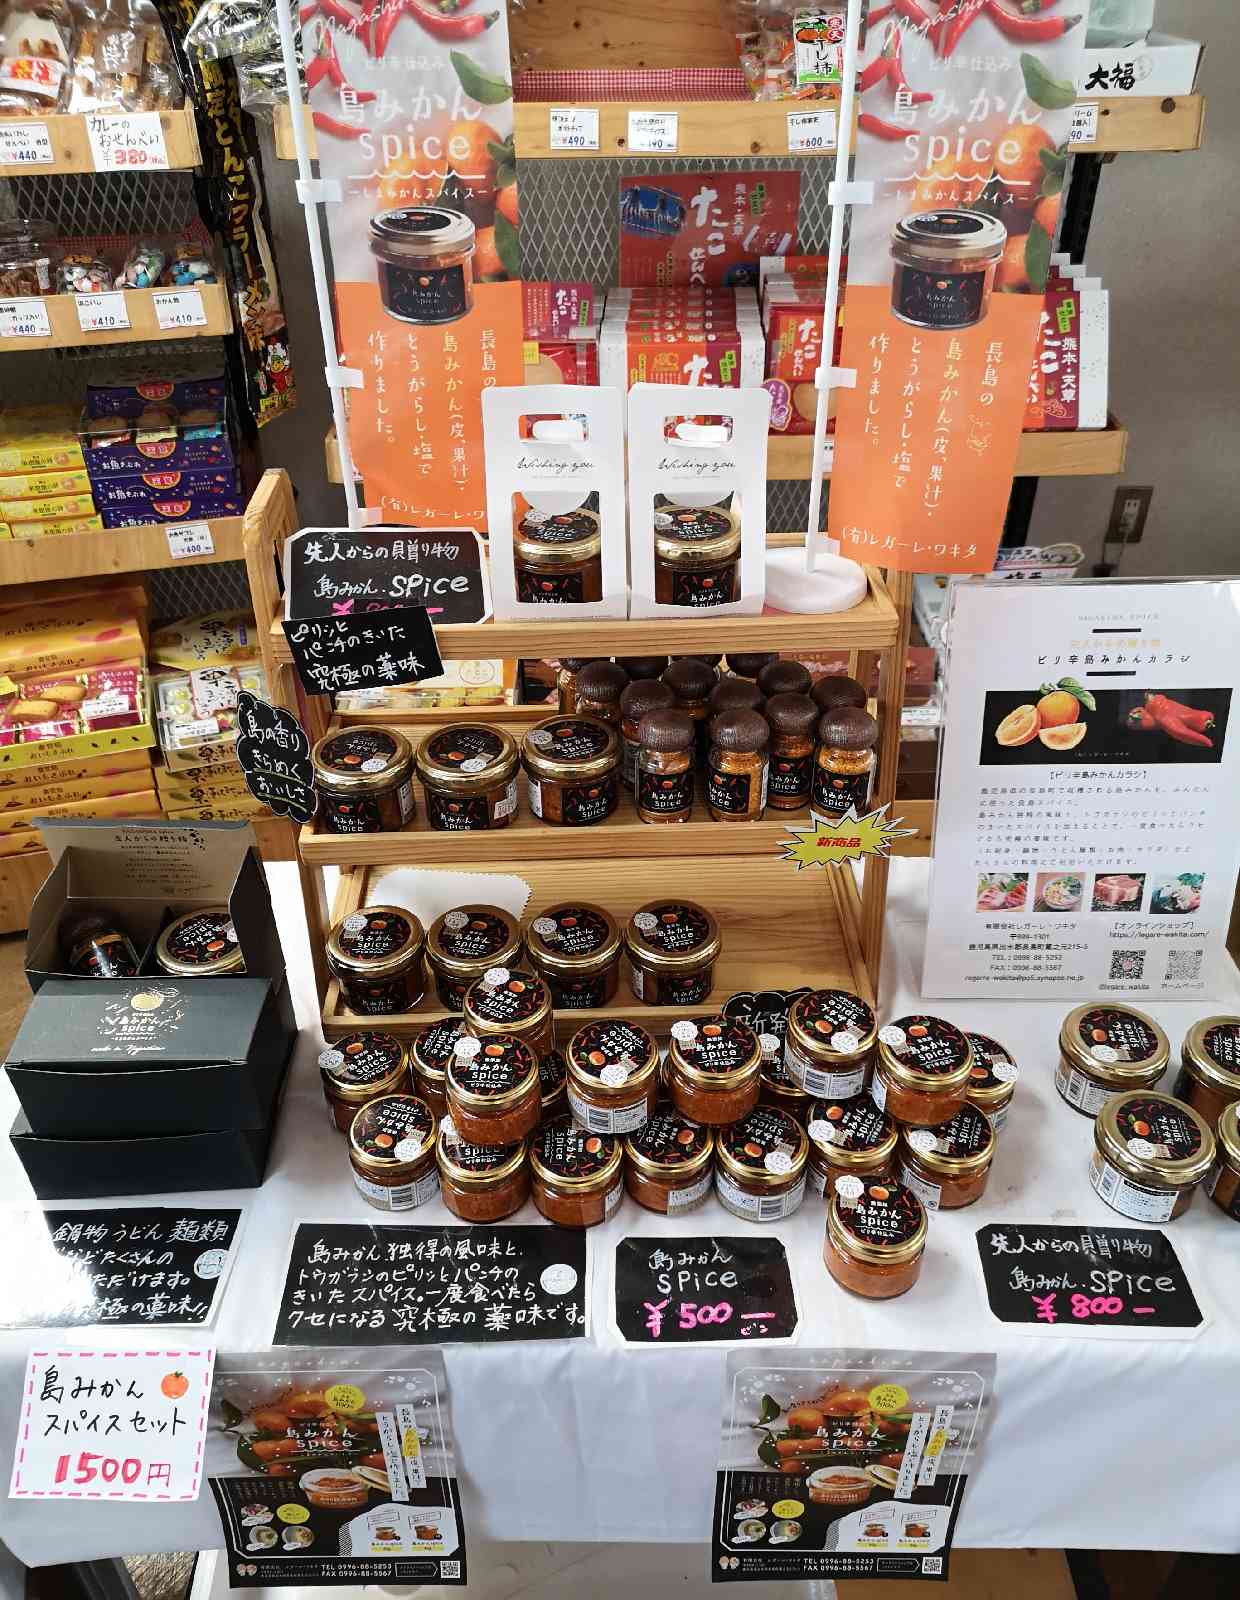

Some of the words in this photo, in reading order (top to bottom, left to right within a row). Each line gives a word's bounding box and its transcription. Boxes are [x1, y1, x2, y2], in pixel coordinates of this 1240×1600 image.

[1084, 62, 1136, 91] 大福
[340, 83, 482, 126] 島みかん
[894, 86, 1042, 126] 島みかん
[90, 116, 130, 133] カレーの
[99, 131, 160, 147] おせんべい
[359, 124, 472, 167] spice
[903, 126, 1023, 173] spice
[690, 186, 730, 256] たこ
[479, 329, 497, 387] 長島の
[1060, 337, 1079, 404] 熊本・天草
[368, 331, 395, 443] 作りました。
[980, 341, 1003, 406] 長島の
[864, 334, 890, 448] 作りました。
[516, 456, 568, 475] Wishing
[657, 457, 708, 475] Wishing
[303, 539, 460, 564] 先人からの贈り物
[842, 526, 977, 559] (有)レガーレ・ワキタ
[303, 625, 406, 660] パンチのきいた
[307, 651, 425, 692] 究極の薬味
[246, 710, 300, 752] 島の香り
[251, 749, 301, 780] きらめく
[256, 775, 306, 803] おいしさ
[816, 836, 862, 848] 新商品
[120, 1024, 156, 1033] spice
[469, 1062, 513, 1073] 島みかん
[701, 1049, 737, 1060] spice
[919, 1048, 952, 1061] spice
[471, 1071, 509, 1080] spice
[855, 1203, 902, 1220] 島みかん
[860, 1215, 899, 1229] spice
[52, 1222, 108, 1244] 鍋物
[113, 1223, 164, 1243] うどん
[166, 1218, 229, 1243] 麺類
[989, 1233, 1153, 1258] 先人からの贈り物
[649, 1249, 733, 1271] 島みかん
[40, 1364, 144, 1404] 島みかん
[44, 1406, 187, 1437] スパイスセット
[286, 1426, 359, 1439] 島みかん
[816, 1425, 887, 1439] 島みかん
[296, 1439, 353, 1449] spice
[821, 1439, 878, 1449] spice
[53, 1451, 171, 1488] 1500円
